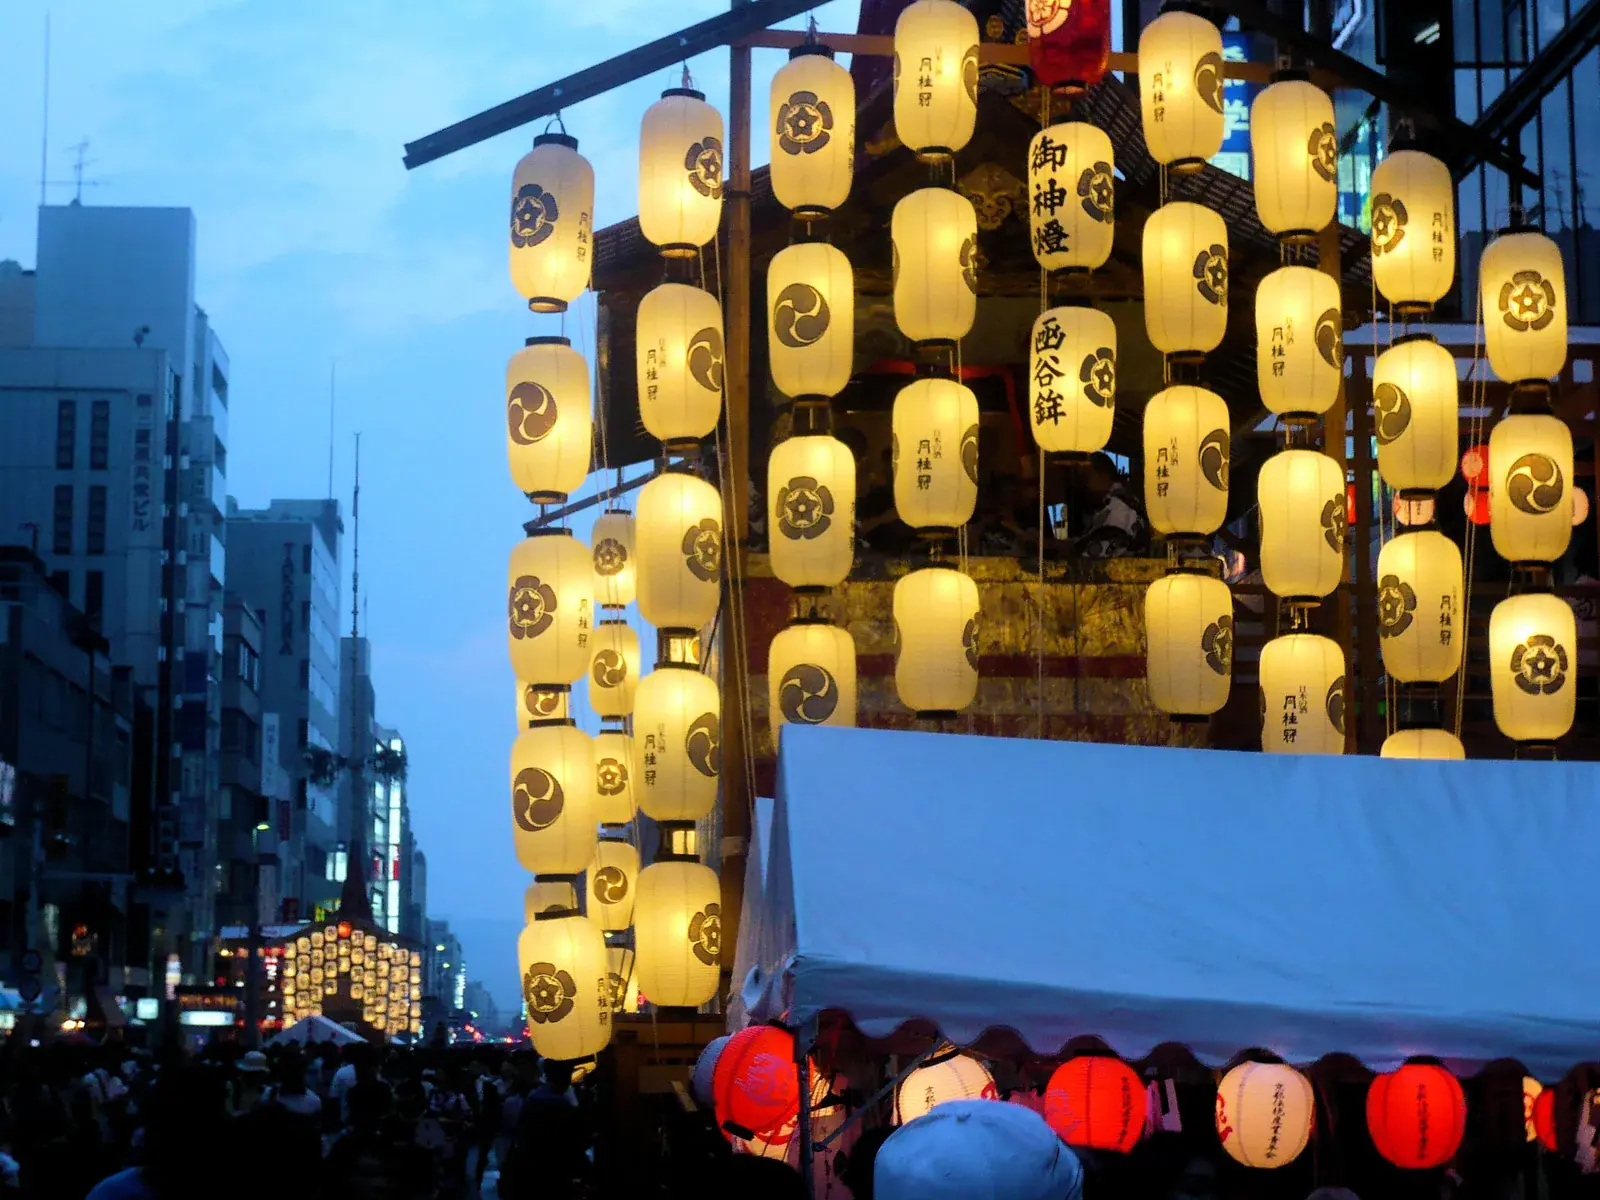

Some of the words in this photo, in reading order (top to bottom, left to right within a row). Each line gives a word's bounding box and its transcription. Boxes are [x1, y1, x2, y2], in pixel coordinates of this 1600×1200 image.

[1032, 136, 1069, 256] 御神燈
[646, 348, 659, 402] 月桂冠
[1272, 326, 1285, 378] 月桂冠
[916, 439, 933, 491] 月桂冠
[1156, 446, 1169, 499] 月桂冠
[1439, 594, 1452, 647] 月桂冠
[1282, 695, 1299, 744] 月桂冠
[644, 734, 657, 787] 月桂冠
